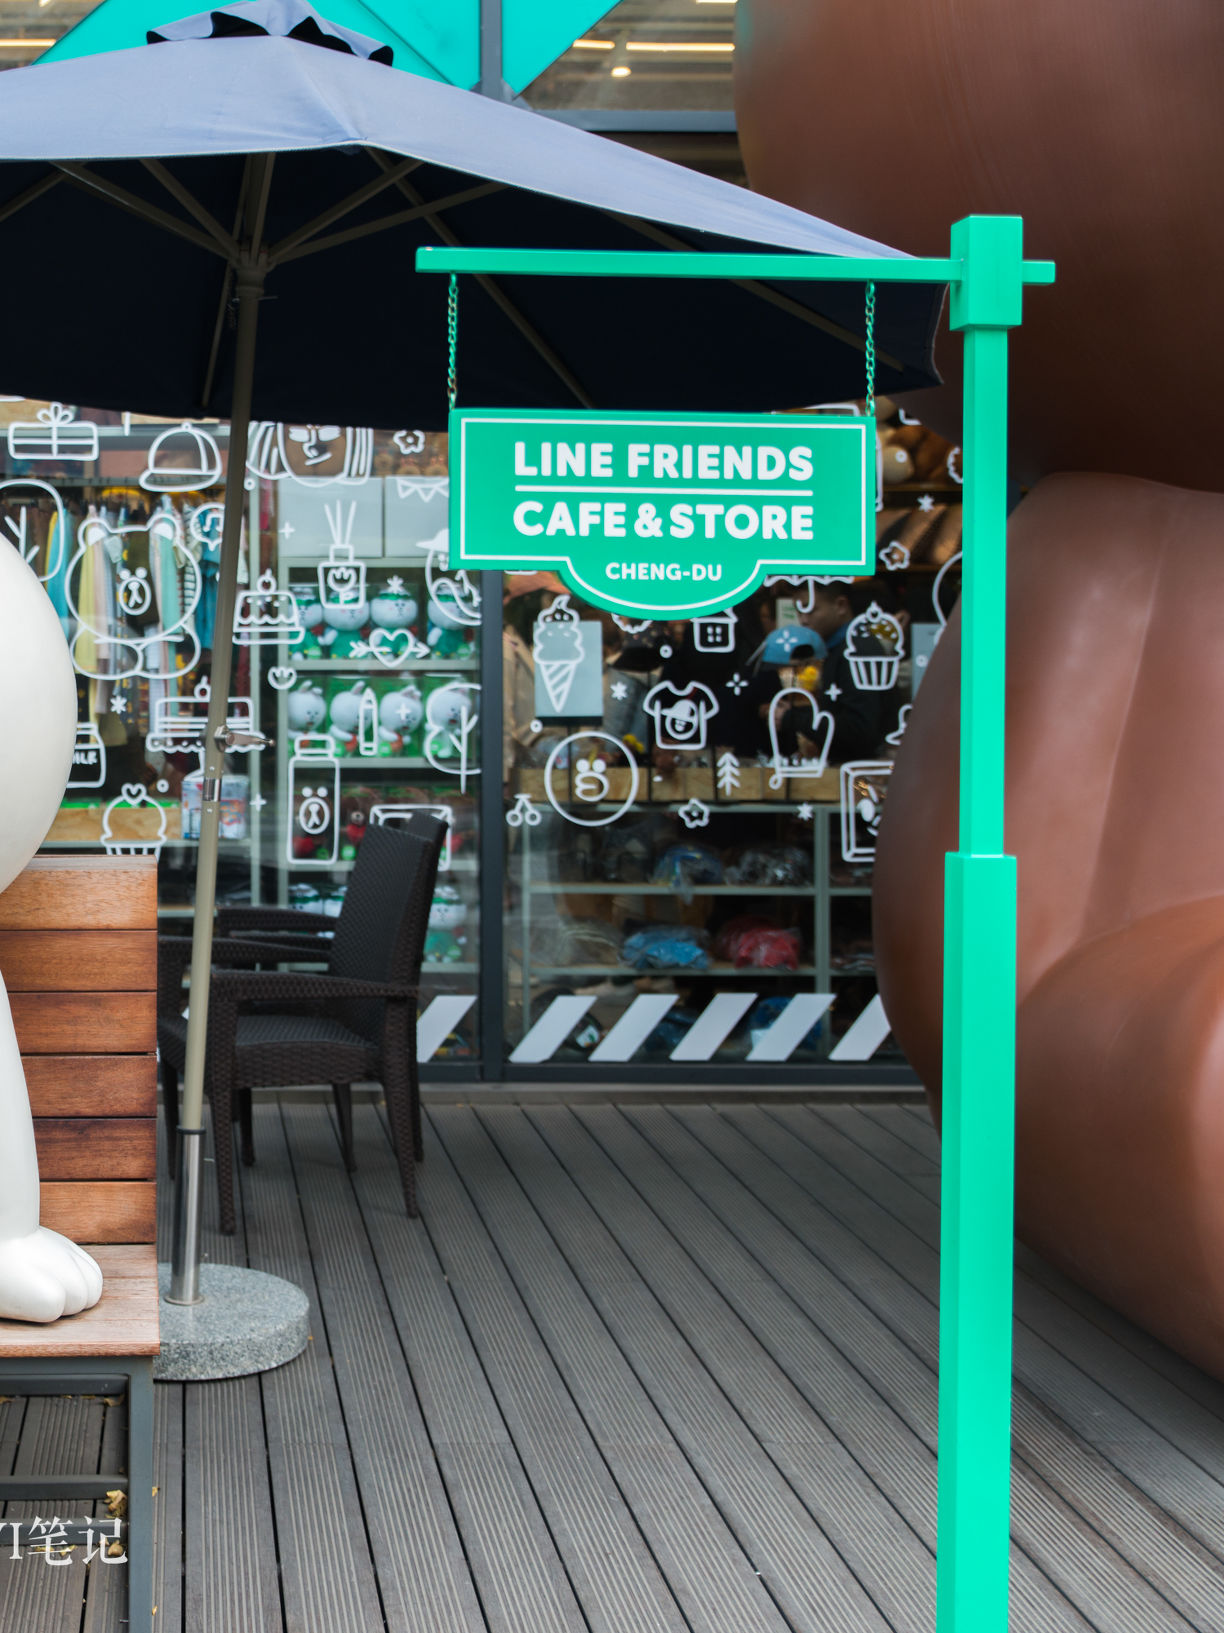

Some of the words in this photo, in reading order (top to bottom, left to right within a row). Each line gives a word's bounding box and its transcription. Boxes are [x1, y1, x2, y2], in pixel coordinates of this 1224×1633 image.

[514, 442, 613, 477] LINE
[627, 443, 814, 482] FRIENDS
[605, 562, 722, 581] CHENG-DU
